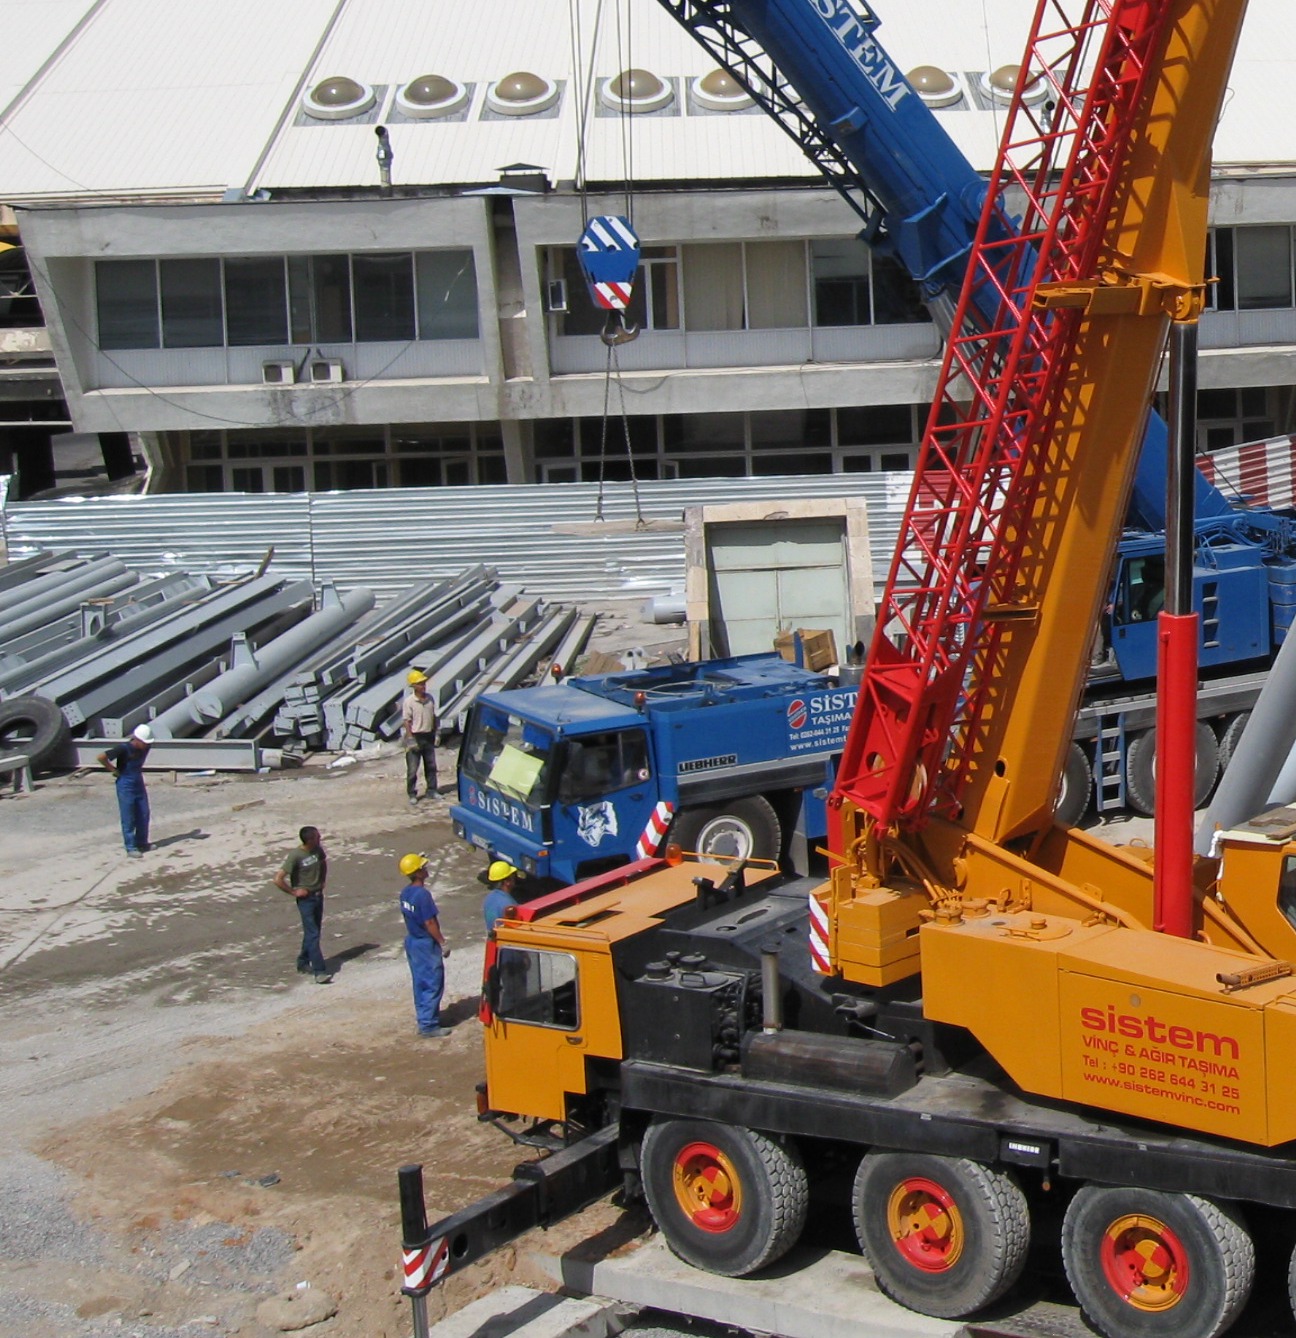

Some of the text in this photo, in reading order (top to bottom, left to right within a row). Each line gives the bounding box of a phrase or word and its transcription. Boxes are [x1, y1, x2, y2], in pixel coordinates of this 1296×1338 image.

[679, 754, 737, 773] LIEBHERR
[1080, 1004, 1239, 1060] sistem
[1082, 1035, 1240, 1080] VİNÇ & AĞIR TAŞIMA
[1082, 1054, 1099, 1068] Tel
[1112, 1061, 1136, 1076] +90
[1140, 1067, 1165, 1083] 262
[1170, 1074, 1196, 1090] 644
[1201, 1081, 1216, 1095] 31
[1222, 1085, 1240, 1100] 25
[1083, 1072, 1240, 1115] www.sistemvinc.com
